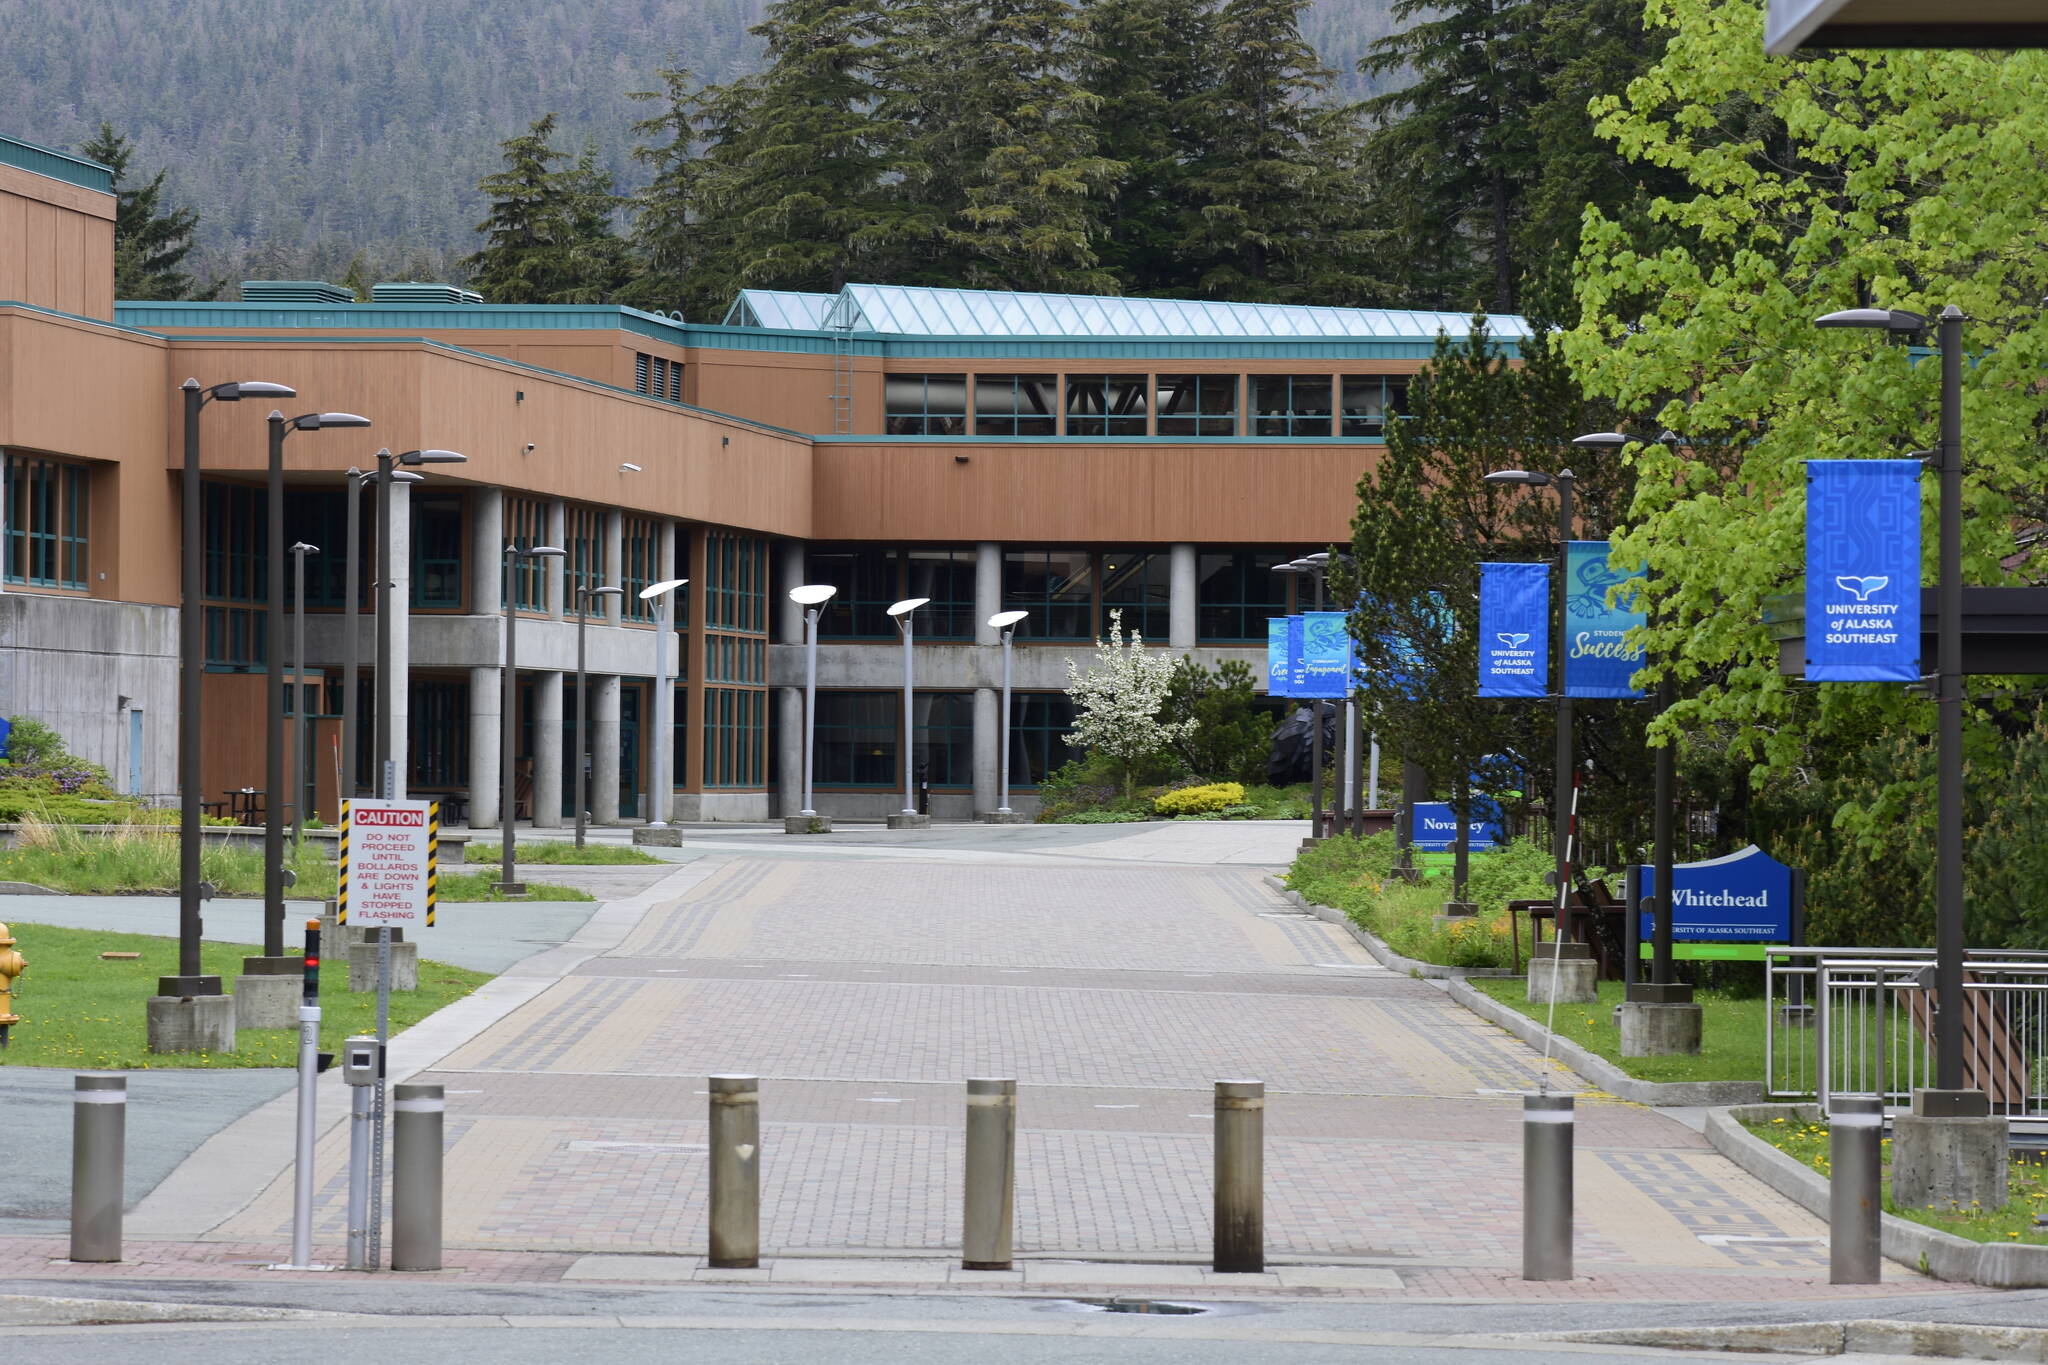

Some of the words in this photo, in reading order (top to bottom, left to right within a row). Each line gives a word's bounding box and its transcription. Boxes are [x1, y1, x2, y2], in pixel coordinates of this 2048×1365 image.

[1826, 604, 1899, 615] UNIVERSITY
[1831, 619, 1844, 631] of
[1845, 619, 1893, 629] ALASKA
[1825, 633, 1899, 643] SOUTHEAST
[1570, 631, 1646, 662] Success
[1494, 659, 1503, 667] of
[1490, 667, 1535, 675] SOUTHEAST
[356, 811, 424, 825] CAUTION
[1424, 818, 1485, 834] Novaey
[366, 833, 384, 841] DO
[387, 833, 411, 842] NOT
[361, 843, 416, 852] PROCEED
[372, 853, 404, 861] UNTIL
[357, 863, 419, 871] BOLLARDS
[357, 872, 380, 880] ARE
[384, 873, 420, 881] DOWN
[361, 882, 369, 890] &
[374, 883, 415, 891] LIGHTS
[373, 892, 402, 900] HAVE
[1672, 888, 1768, 907] Whitehead
[361, 901, 413, 909] STOPPED
[359, 910, 415, 919] FLASHING
